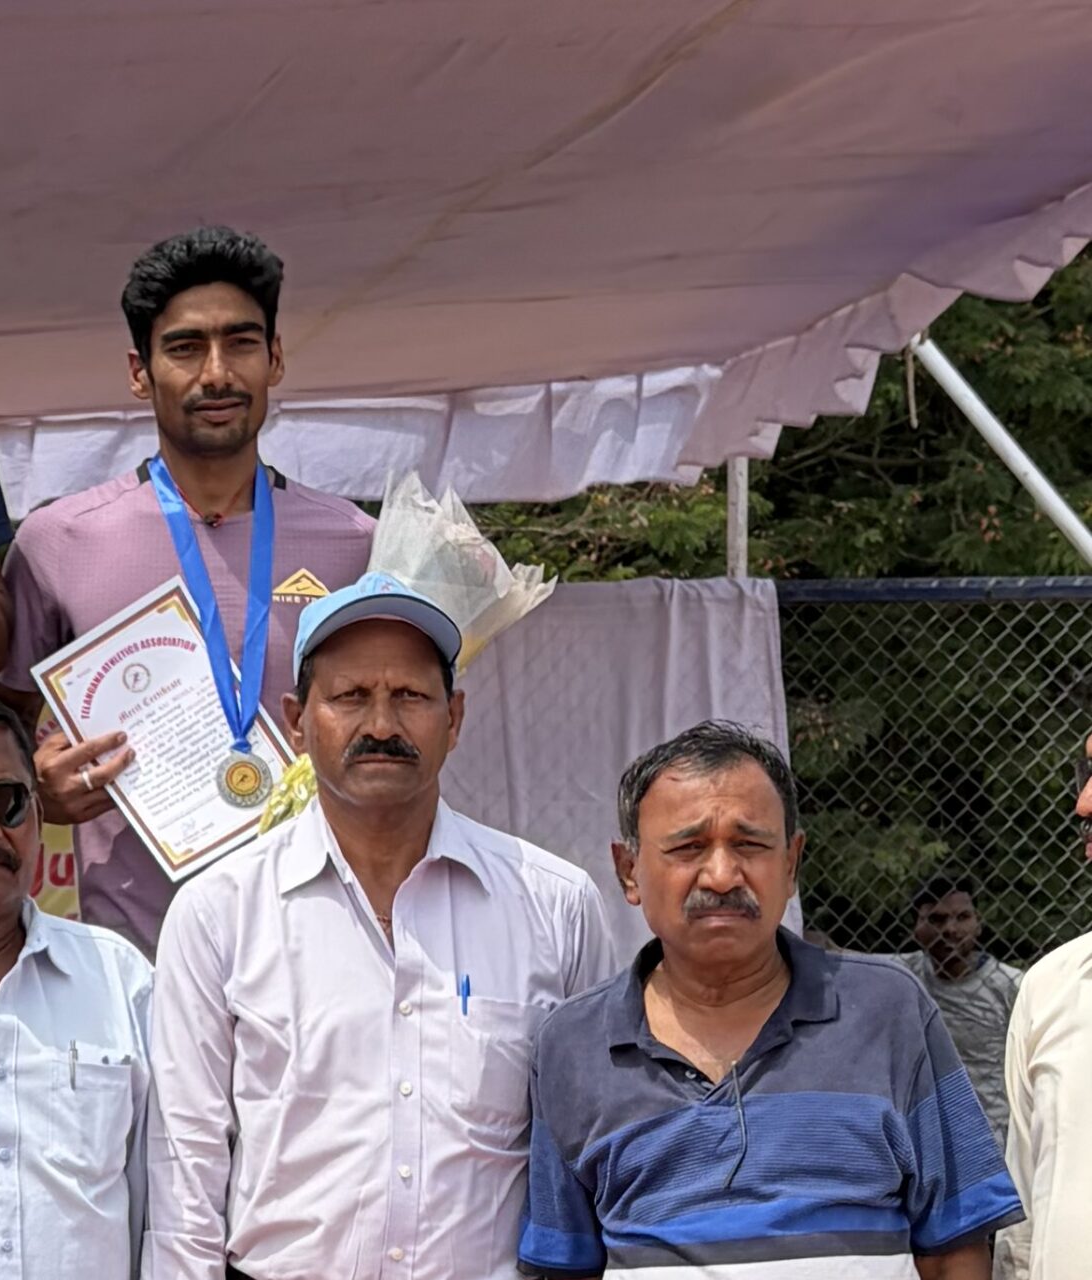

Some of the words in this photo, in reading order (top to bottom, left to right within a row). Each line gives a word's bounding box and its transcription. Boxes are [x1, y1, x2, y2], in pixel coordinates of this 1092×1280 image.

[272, 595, 301, 604] NIKE
[80, 671, 105, 719] TELANGANA
[101, 642, 140, 674] ATHLETICS
[140, 636, 198, 653] ASSOCIATION
